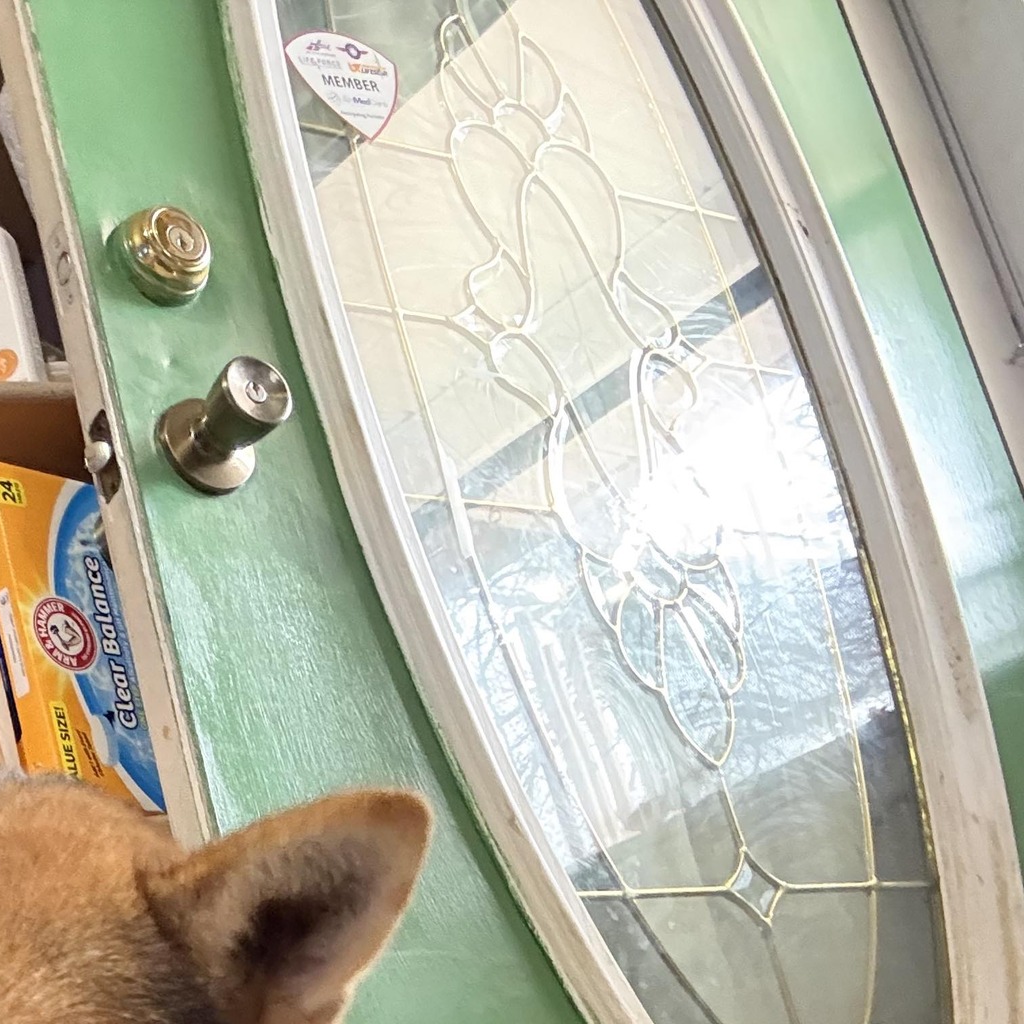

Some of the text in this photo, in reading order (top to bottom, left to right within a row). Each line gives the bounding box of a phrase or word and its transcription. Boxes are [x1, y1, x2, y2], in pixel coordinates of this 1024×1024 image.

[321, 73, 380, 92] MEMBER
[0, 480, 17, 503] 24
[36, 602, 77, 667] ARM & HAMMER
[85, 556, 138, 729] Clear Balance
[54, 707, 79, 777] ALUE SIZE!
